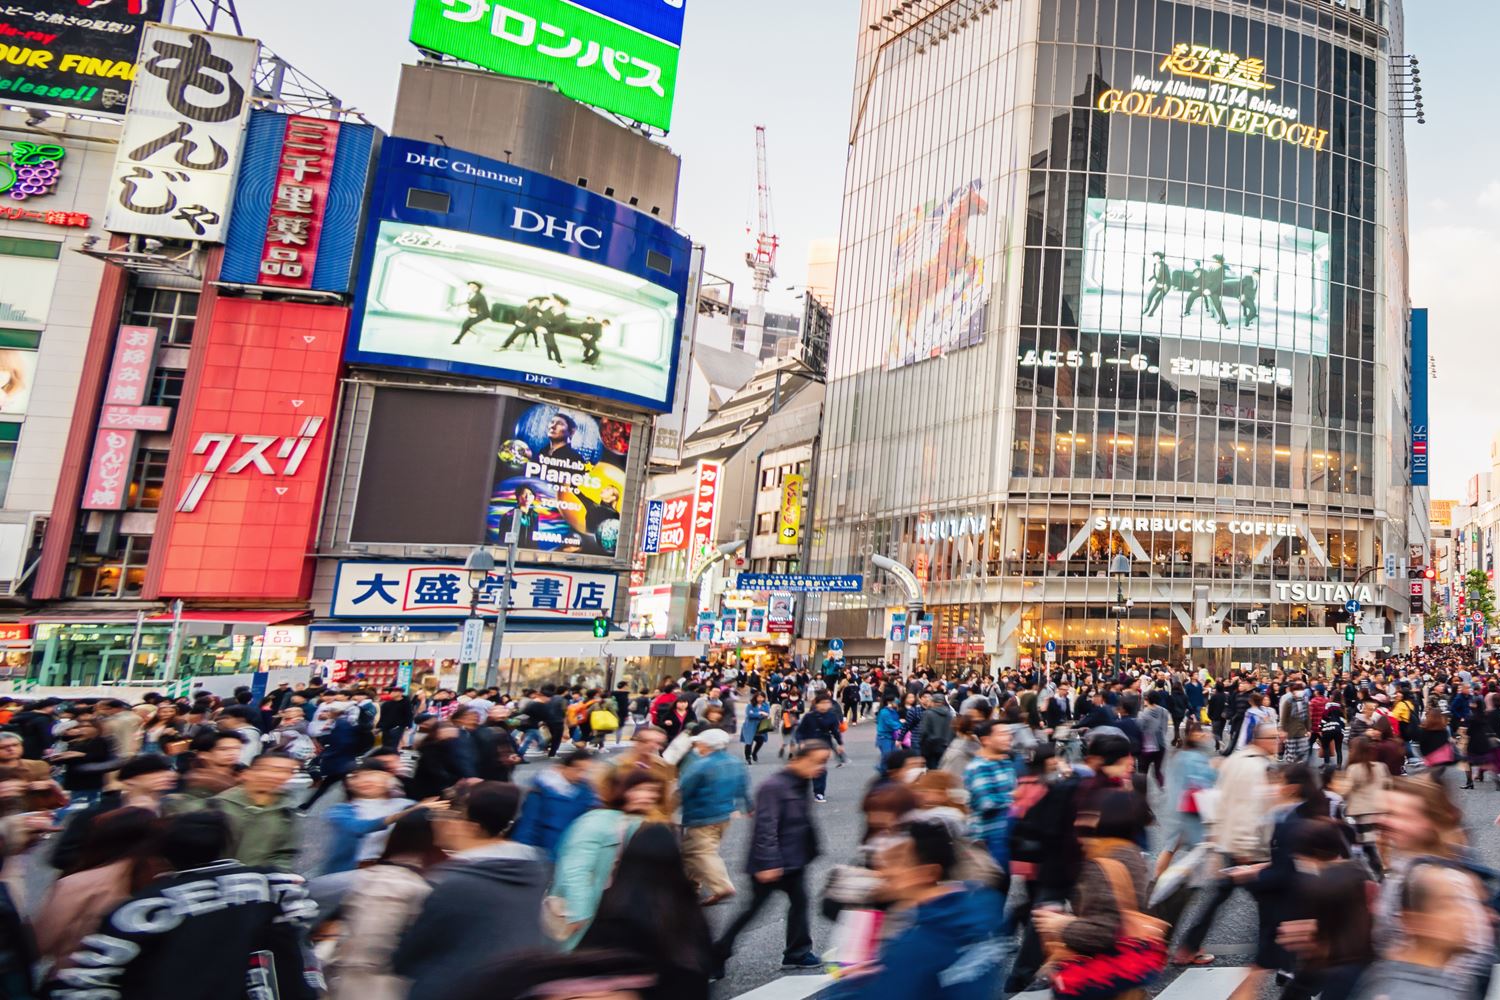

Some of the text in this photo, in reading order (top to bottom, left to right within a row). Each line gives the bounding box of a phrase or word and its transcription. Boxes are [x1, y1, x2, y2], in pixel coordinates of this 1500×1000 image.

[0, 76, 98, 101] elease!!
[1132, 75, 1298, 120] New Album 11.14 Release
[119, 33, 245, 236] もんじゃ
[1098, 89, 1328, 151] GOLDEN EPOCH
[406, 152, 523, 187] DHC Channel
[260, 120, 328, 278] 三千里薬品
[510, 207, 603, 250] DHC
[525, 373, 553, 385] DHC
[525, 461, 602, 490] Planets
[539, 453, 585, 471] teamLab
[1095, 515, 1297, 537] STARBUCKS COFFEE
[352, 573, 606, 610] 大盛堂書店
[1276, 582, 1373, 603] TSUTAYA
